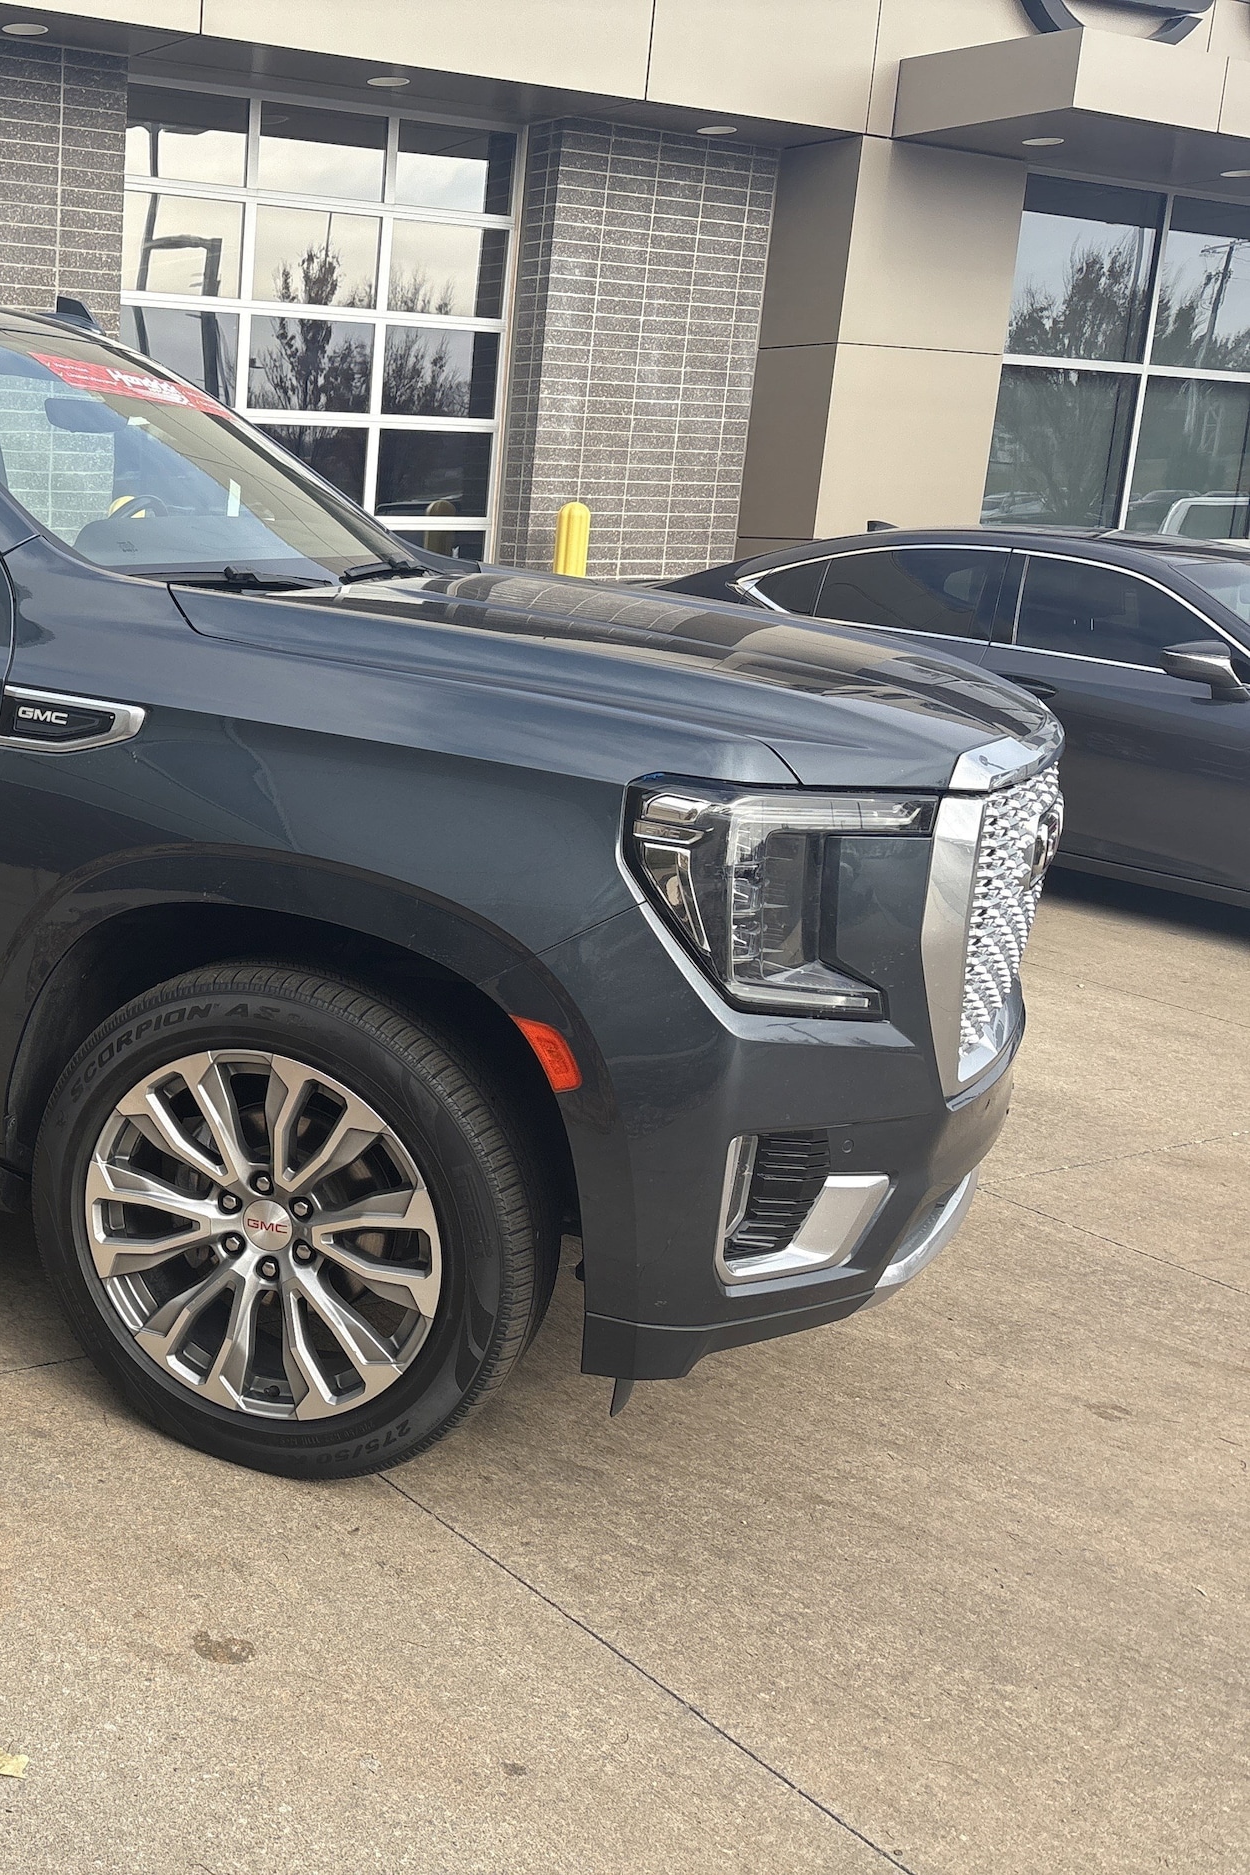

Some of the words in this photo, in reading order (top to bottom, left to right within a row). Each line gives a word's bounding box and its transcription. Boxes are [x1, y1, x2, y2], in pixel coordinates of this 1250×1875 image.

[17, 706, 69, 725] GMC
[69, 1002, 213, 1102] SCORPION
[247, 1218, 288, 1234] GMC
[315, 1418, 412, 1465] 275/50
